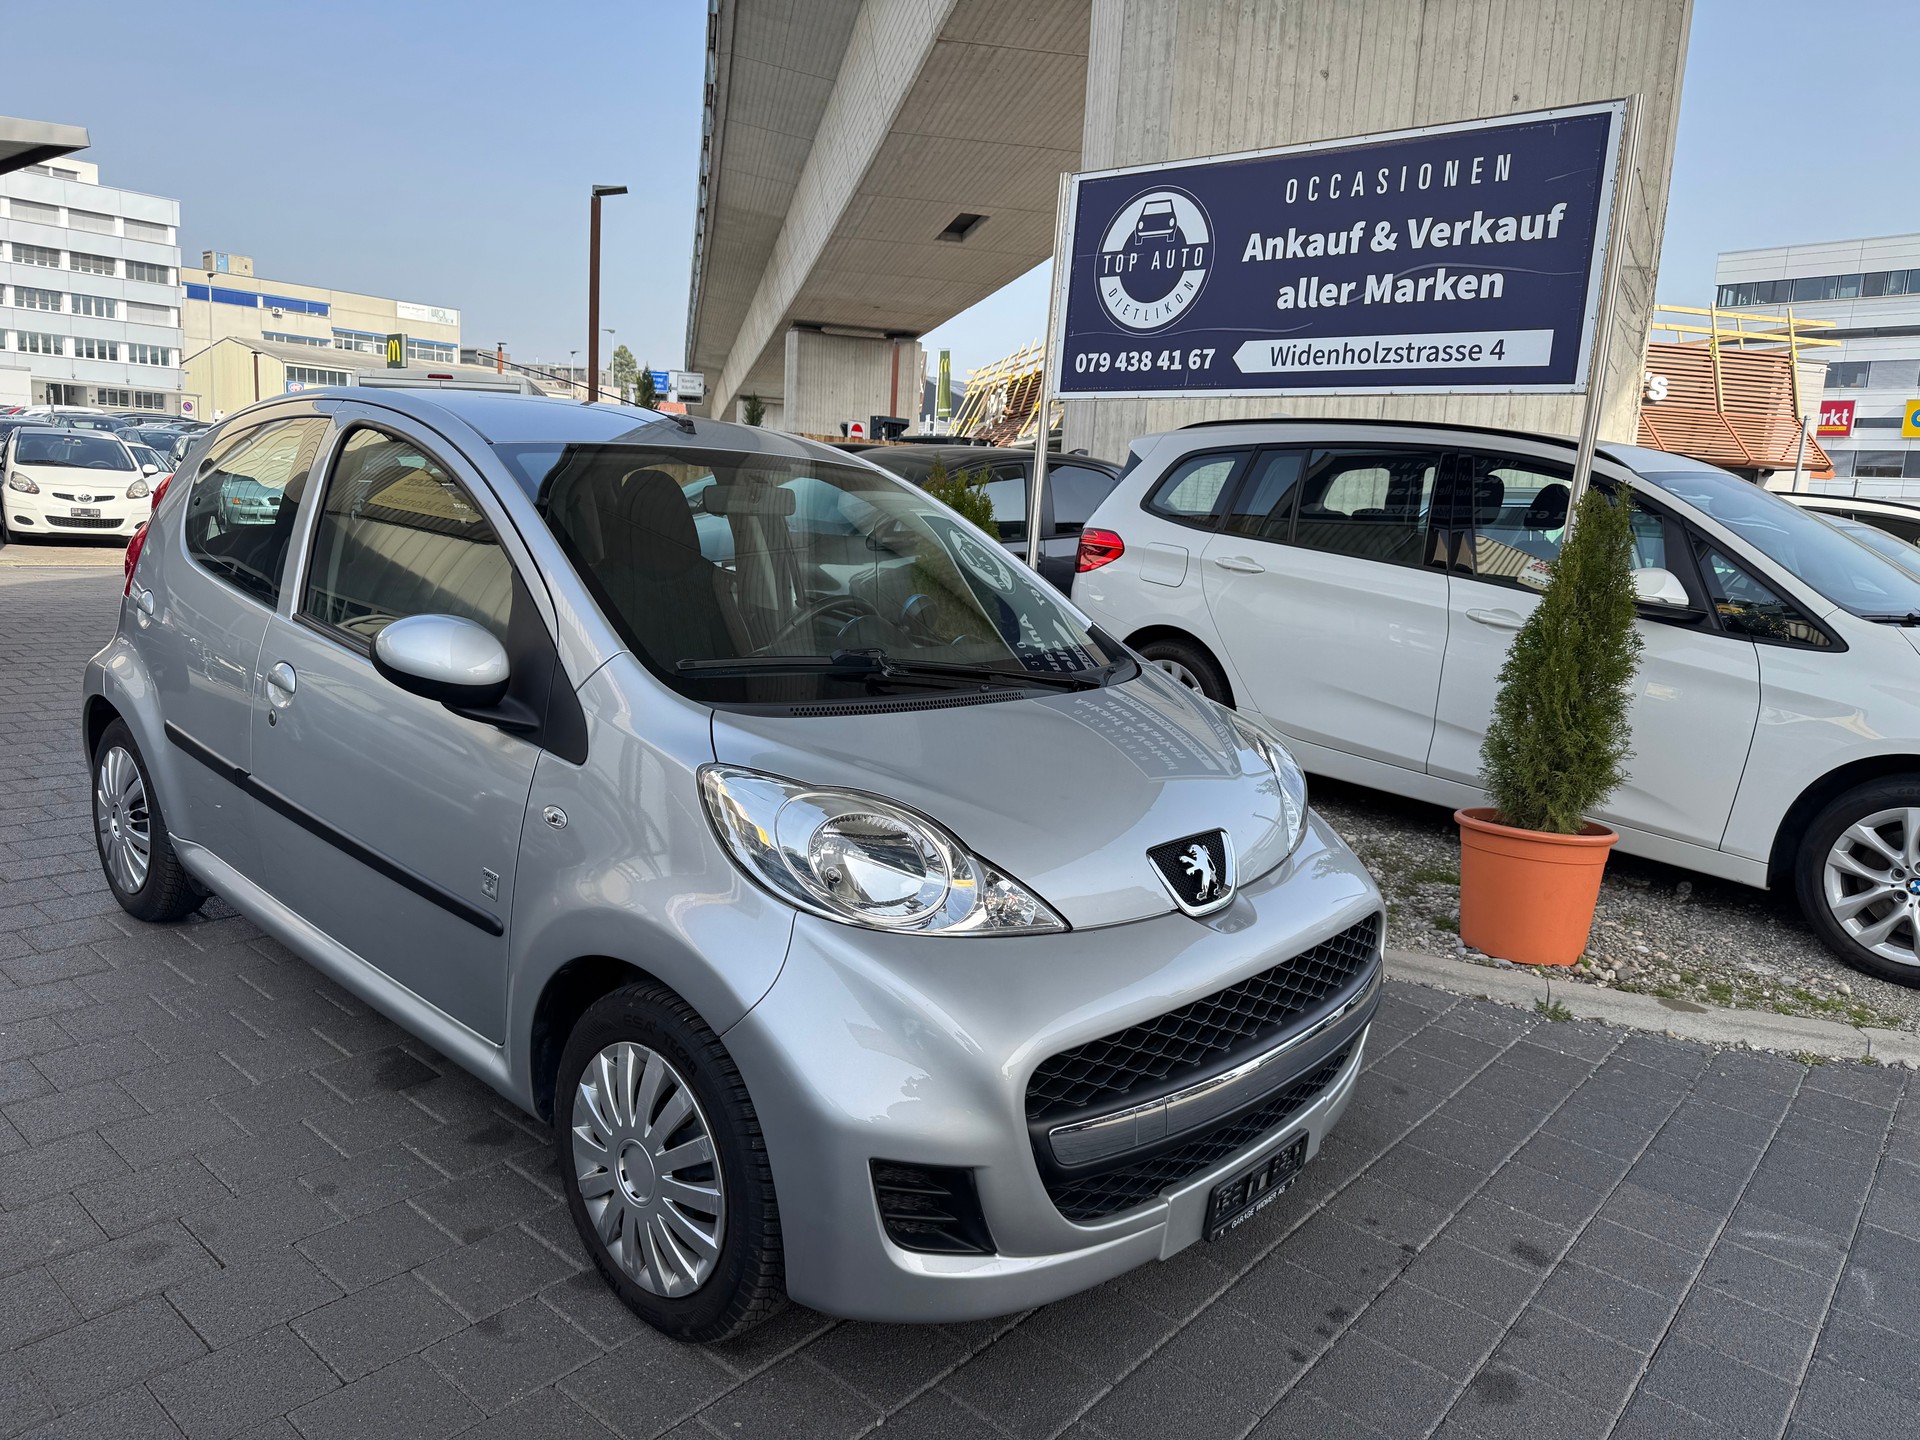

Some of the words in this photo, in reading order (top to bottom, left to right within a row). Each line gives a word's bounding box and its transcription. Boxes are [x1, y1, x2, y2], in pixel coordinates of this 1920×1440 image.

[1285, 153, 1512, 204] OCCASIONEN
[1242, 221, 1366, 262] Ankauf
[1370, 221, 1398, 252] &
[1408, 202, 1568, 249] Verkauf
[1103, 252, 1138, 274] TOP
[1151, 246, 1204, 270] AUTO
[1108, 280, 1194, 321] DIETLIKON
[1276, 276, 1357, 310] aller
[1364, 268, 1504, 304] Marken
[1075, 352, 1111, 374] 079
[1115, 351, 1152, 372] 438
[1157, 350, 1182, 371] 41
[1188, 348, 1216, 370] 67
[1270, 340, 1482, 367] Widenholzstrasse
[1489, 338, 1505, 361] 4
